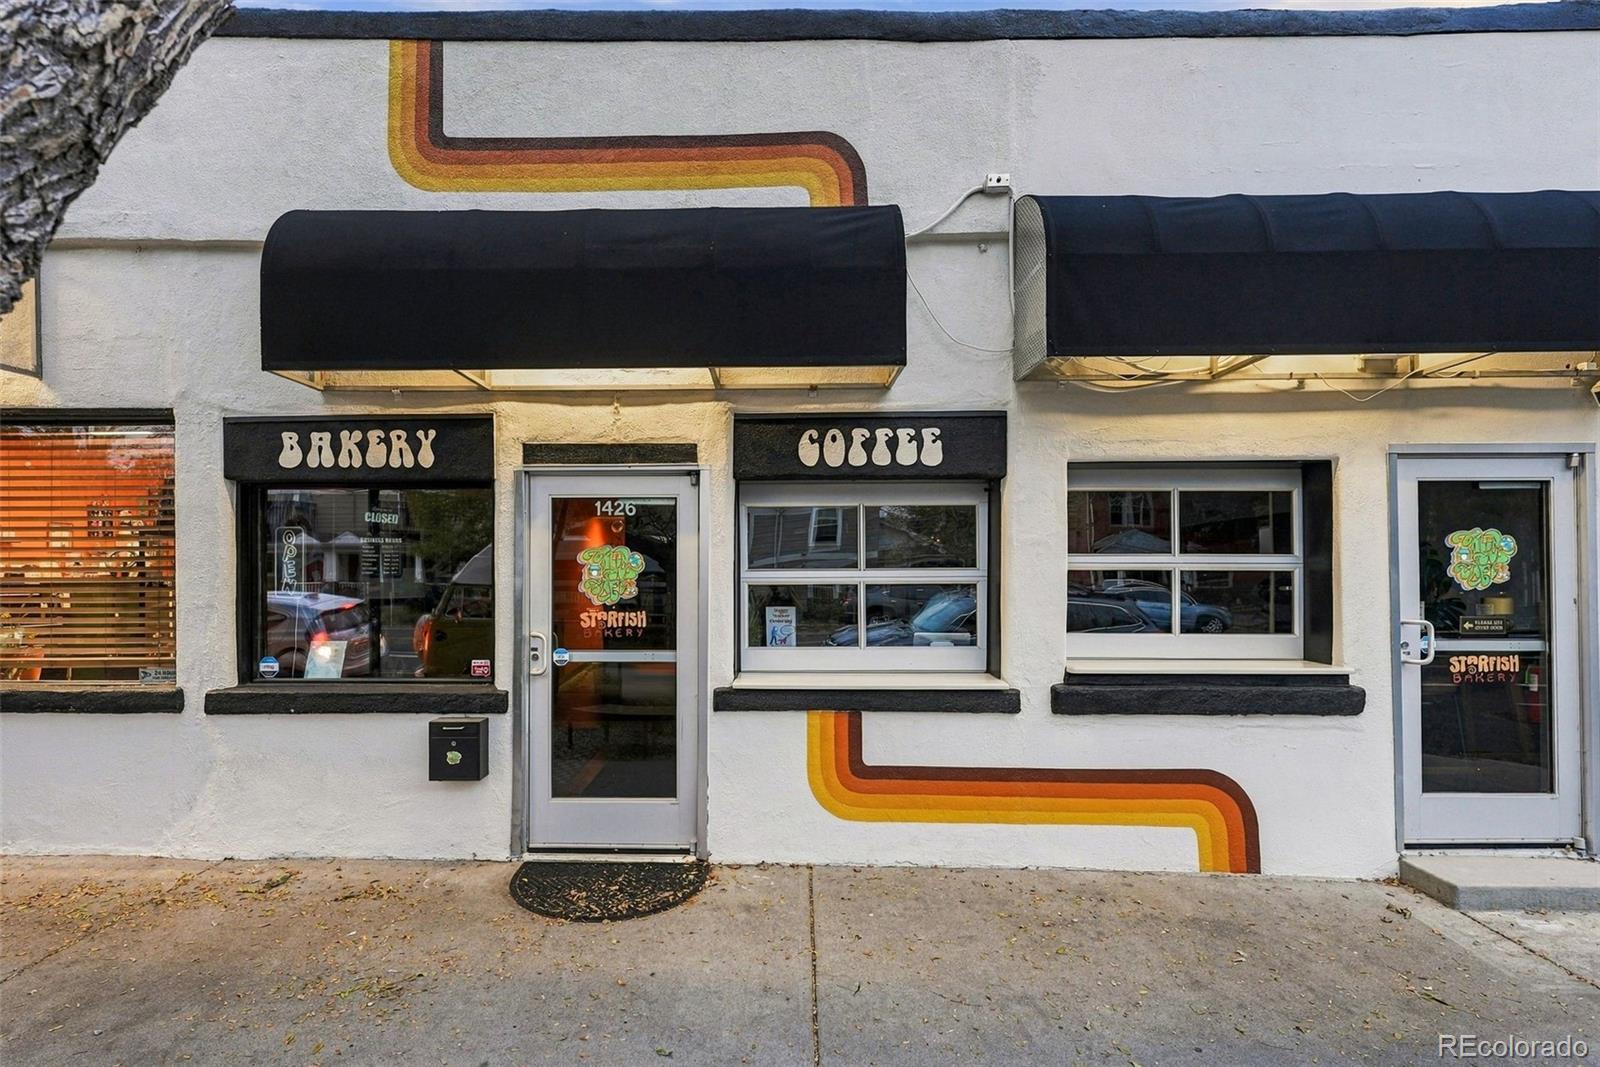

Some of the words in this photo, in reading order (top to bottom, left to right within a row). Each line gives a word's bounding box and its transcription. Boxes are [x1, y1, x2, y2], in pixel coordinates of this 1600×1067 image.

[278, 429, 437, 469] BAKERY
[798, 427, 943, 467] COFFEE
[594, 500, 637, 516] 1426
[364, 511, 399, 525] CLOSED
[580, 610, 647, 628] STARFISH
[583, 628, 644, 638] BAKERY
[1449, 654, 1520, 673] STARFISH
[1453, 672, 1516, 684] BAKERY
